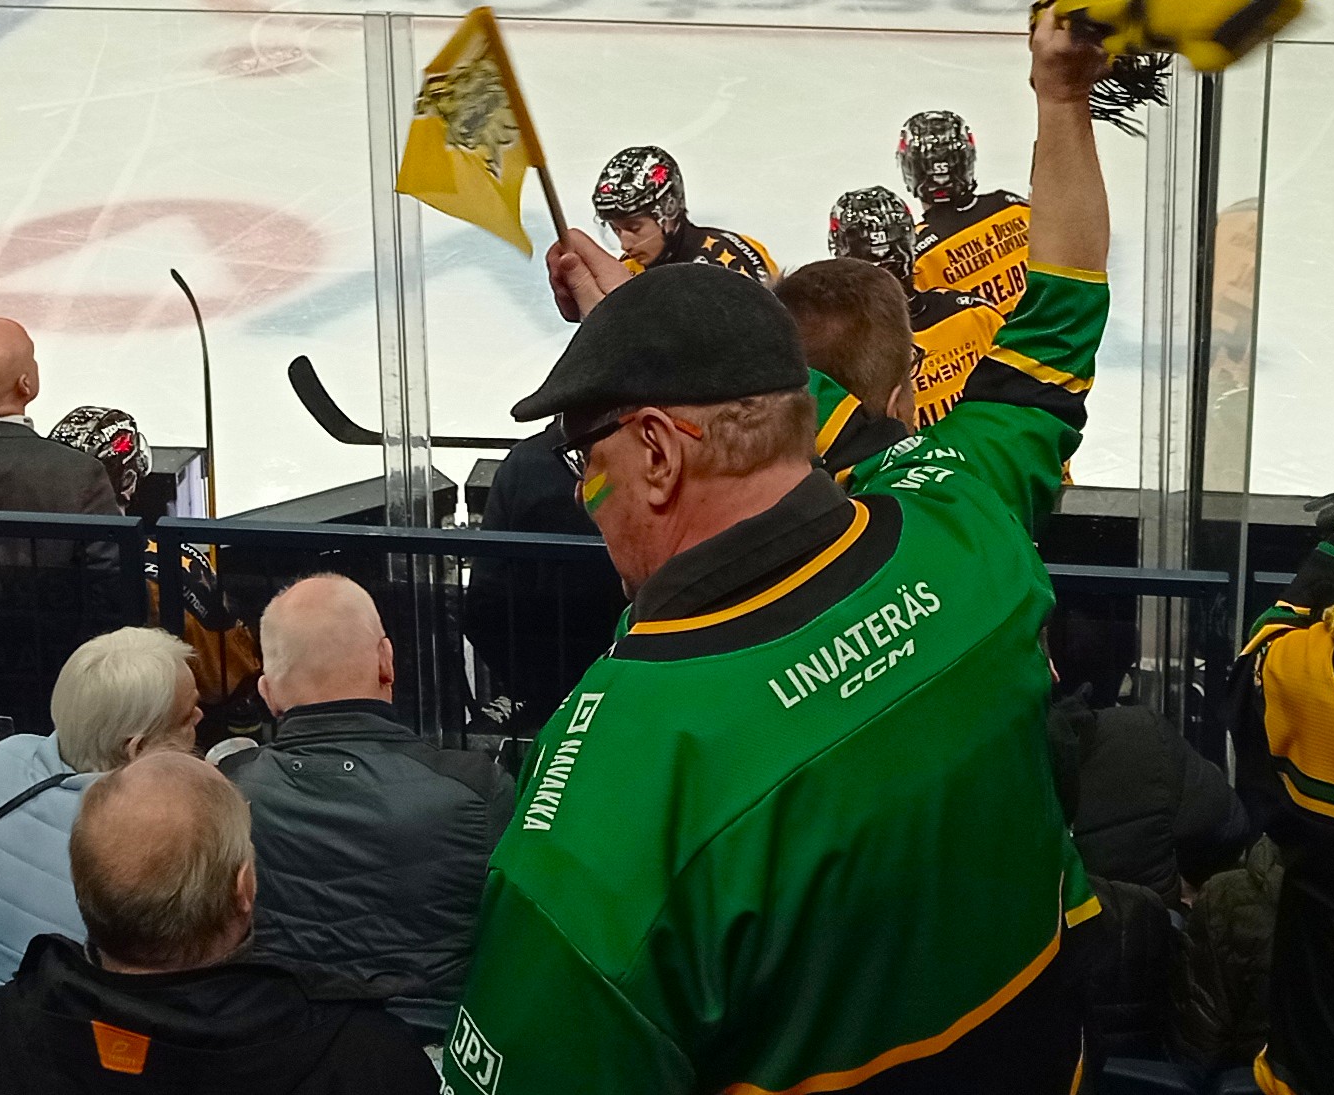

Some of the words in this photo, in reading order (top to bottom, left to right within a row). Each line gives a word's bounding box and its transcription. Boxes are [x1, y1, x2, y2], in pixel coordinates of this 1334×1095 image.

[933, 162, 948, 174] 55
[870, 231, 887, 245] 50
[942, 251, 995, 286] GALLERY
[916, 350, 980, 392] EMENTTI
[767, 580, 942, 710] LINJATERÄS
[840, 638, 916, 701] CCM
[523, 740, 583, 831] NAVAKKA
[455, 1017, 496, 1086] JPJ
